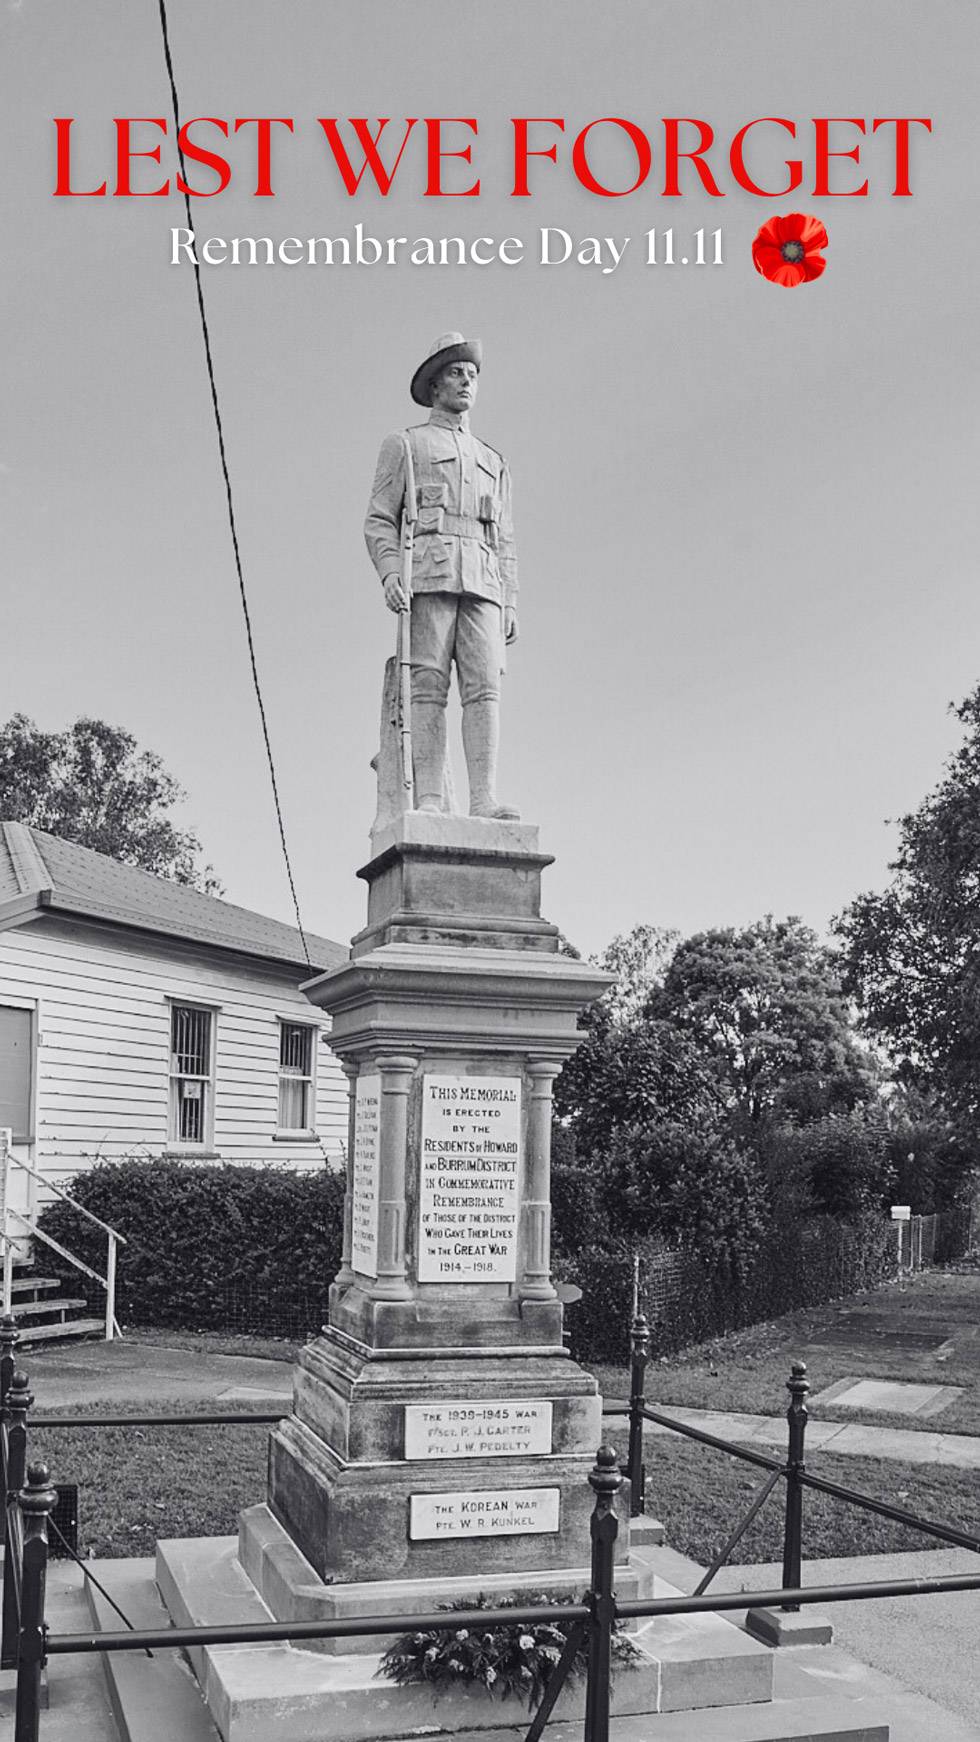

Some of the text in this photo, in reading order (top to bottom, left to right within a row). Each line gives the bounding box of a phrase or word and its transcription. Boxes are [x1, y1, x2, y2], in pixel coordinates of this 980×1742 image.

[429, 1086, 458, 1100] THIS
[442, 1108, 501, 1118] IS ERECTED
[452, 1125, 491, 1134] BY THE
[424, 1138, 475, 1153] RESIDENTS
[483, 1140, 518, 1154] HOWARD
[424, 1157, 517, 1173] AND BURRUM DISTRICT
[425, 1176, 515, 1191] IN COMMEMORATIVE
[433, 1194, 504, 1208] REMEMBRANCE
[422, 1213, 516, 1224] OF THOSE OF THE DISTRICT
[425, 1228, 514, 1239] WHO GAVE THEIR LIVES
[427, 1243, 508, 1256] IN THE GREAT WAR
[422, 1412, 442, 1422] THE
[515, 1410, 538, 1419] WAR
[486, 1425, 531, 1436] CARTER
[479, 1441, 531, 1452] PEDELTY
[435, 1501, 537, 1515] THE KOREAN WAR
[491, 1517, 535, 1527] KUNKEL
